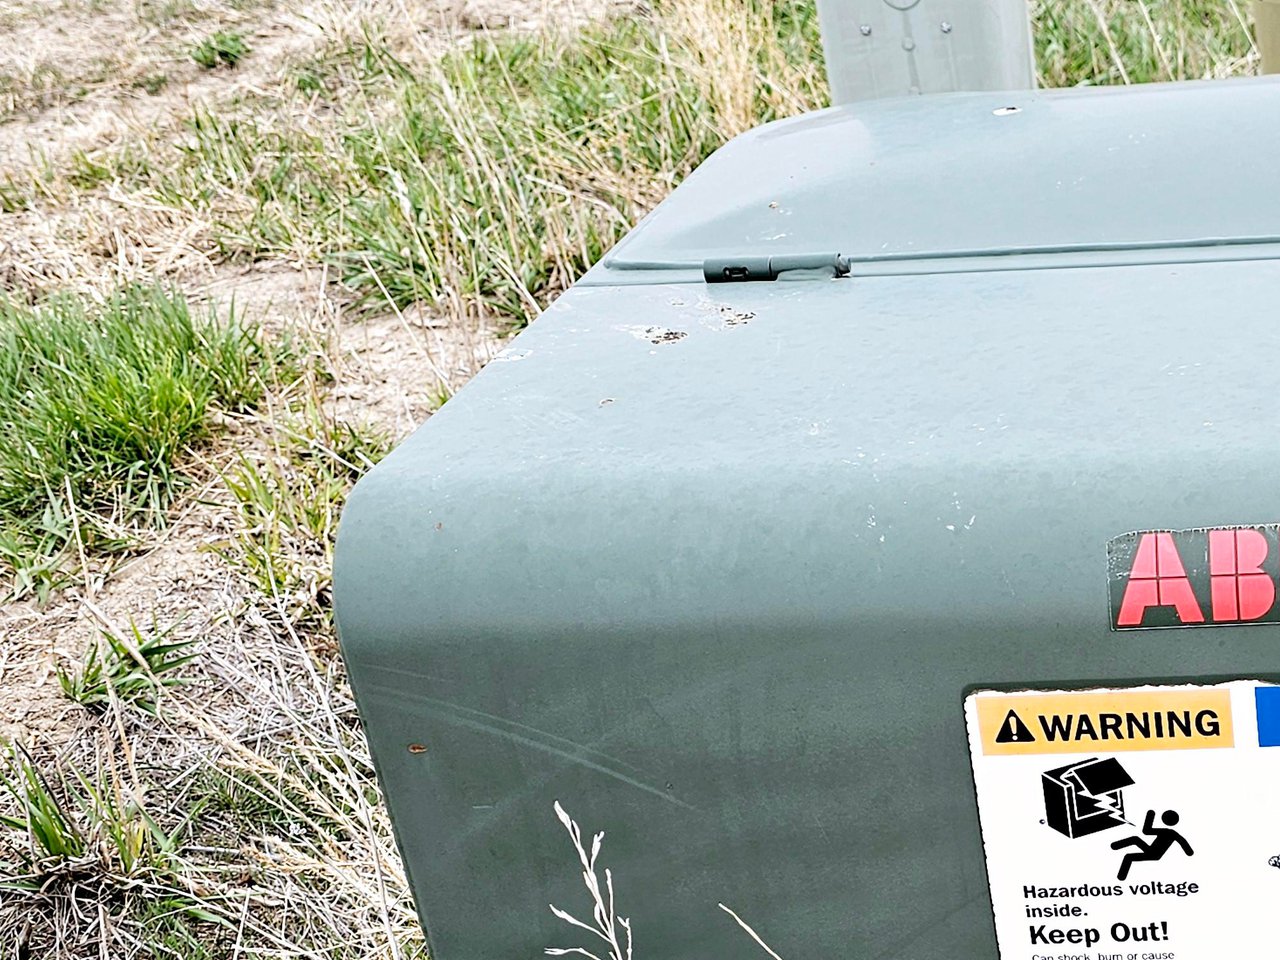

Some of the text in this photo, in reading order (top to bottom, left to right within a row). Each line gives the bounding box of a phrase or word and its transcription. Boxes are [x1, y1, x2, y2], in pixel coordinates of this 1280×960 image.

[1038, 709, 1220, 741] WARNING
[1023, 882, 1199, 899] Hazardous voltage
[1026, 904, 1088, 918] inside.
[1029, 921, 1169, 948] Keep Out!
[1098, 953, 1123, 960] burn
[1142, 952, 1175, 960] cause
